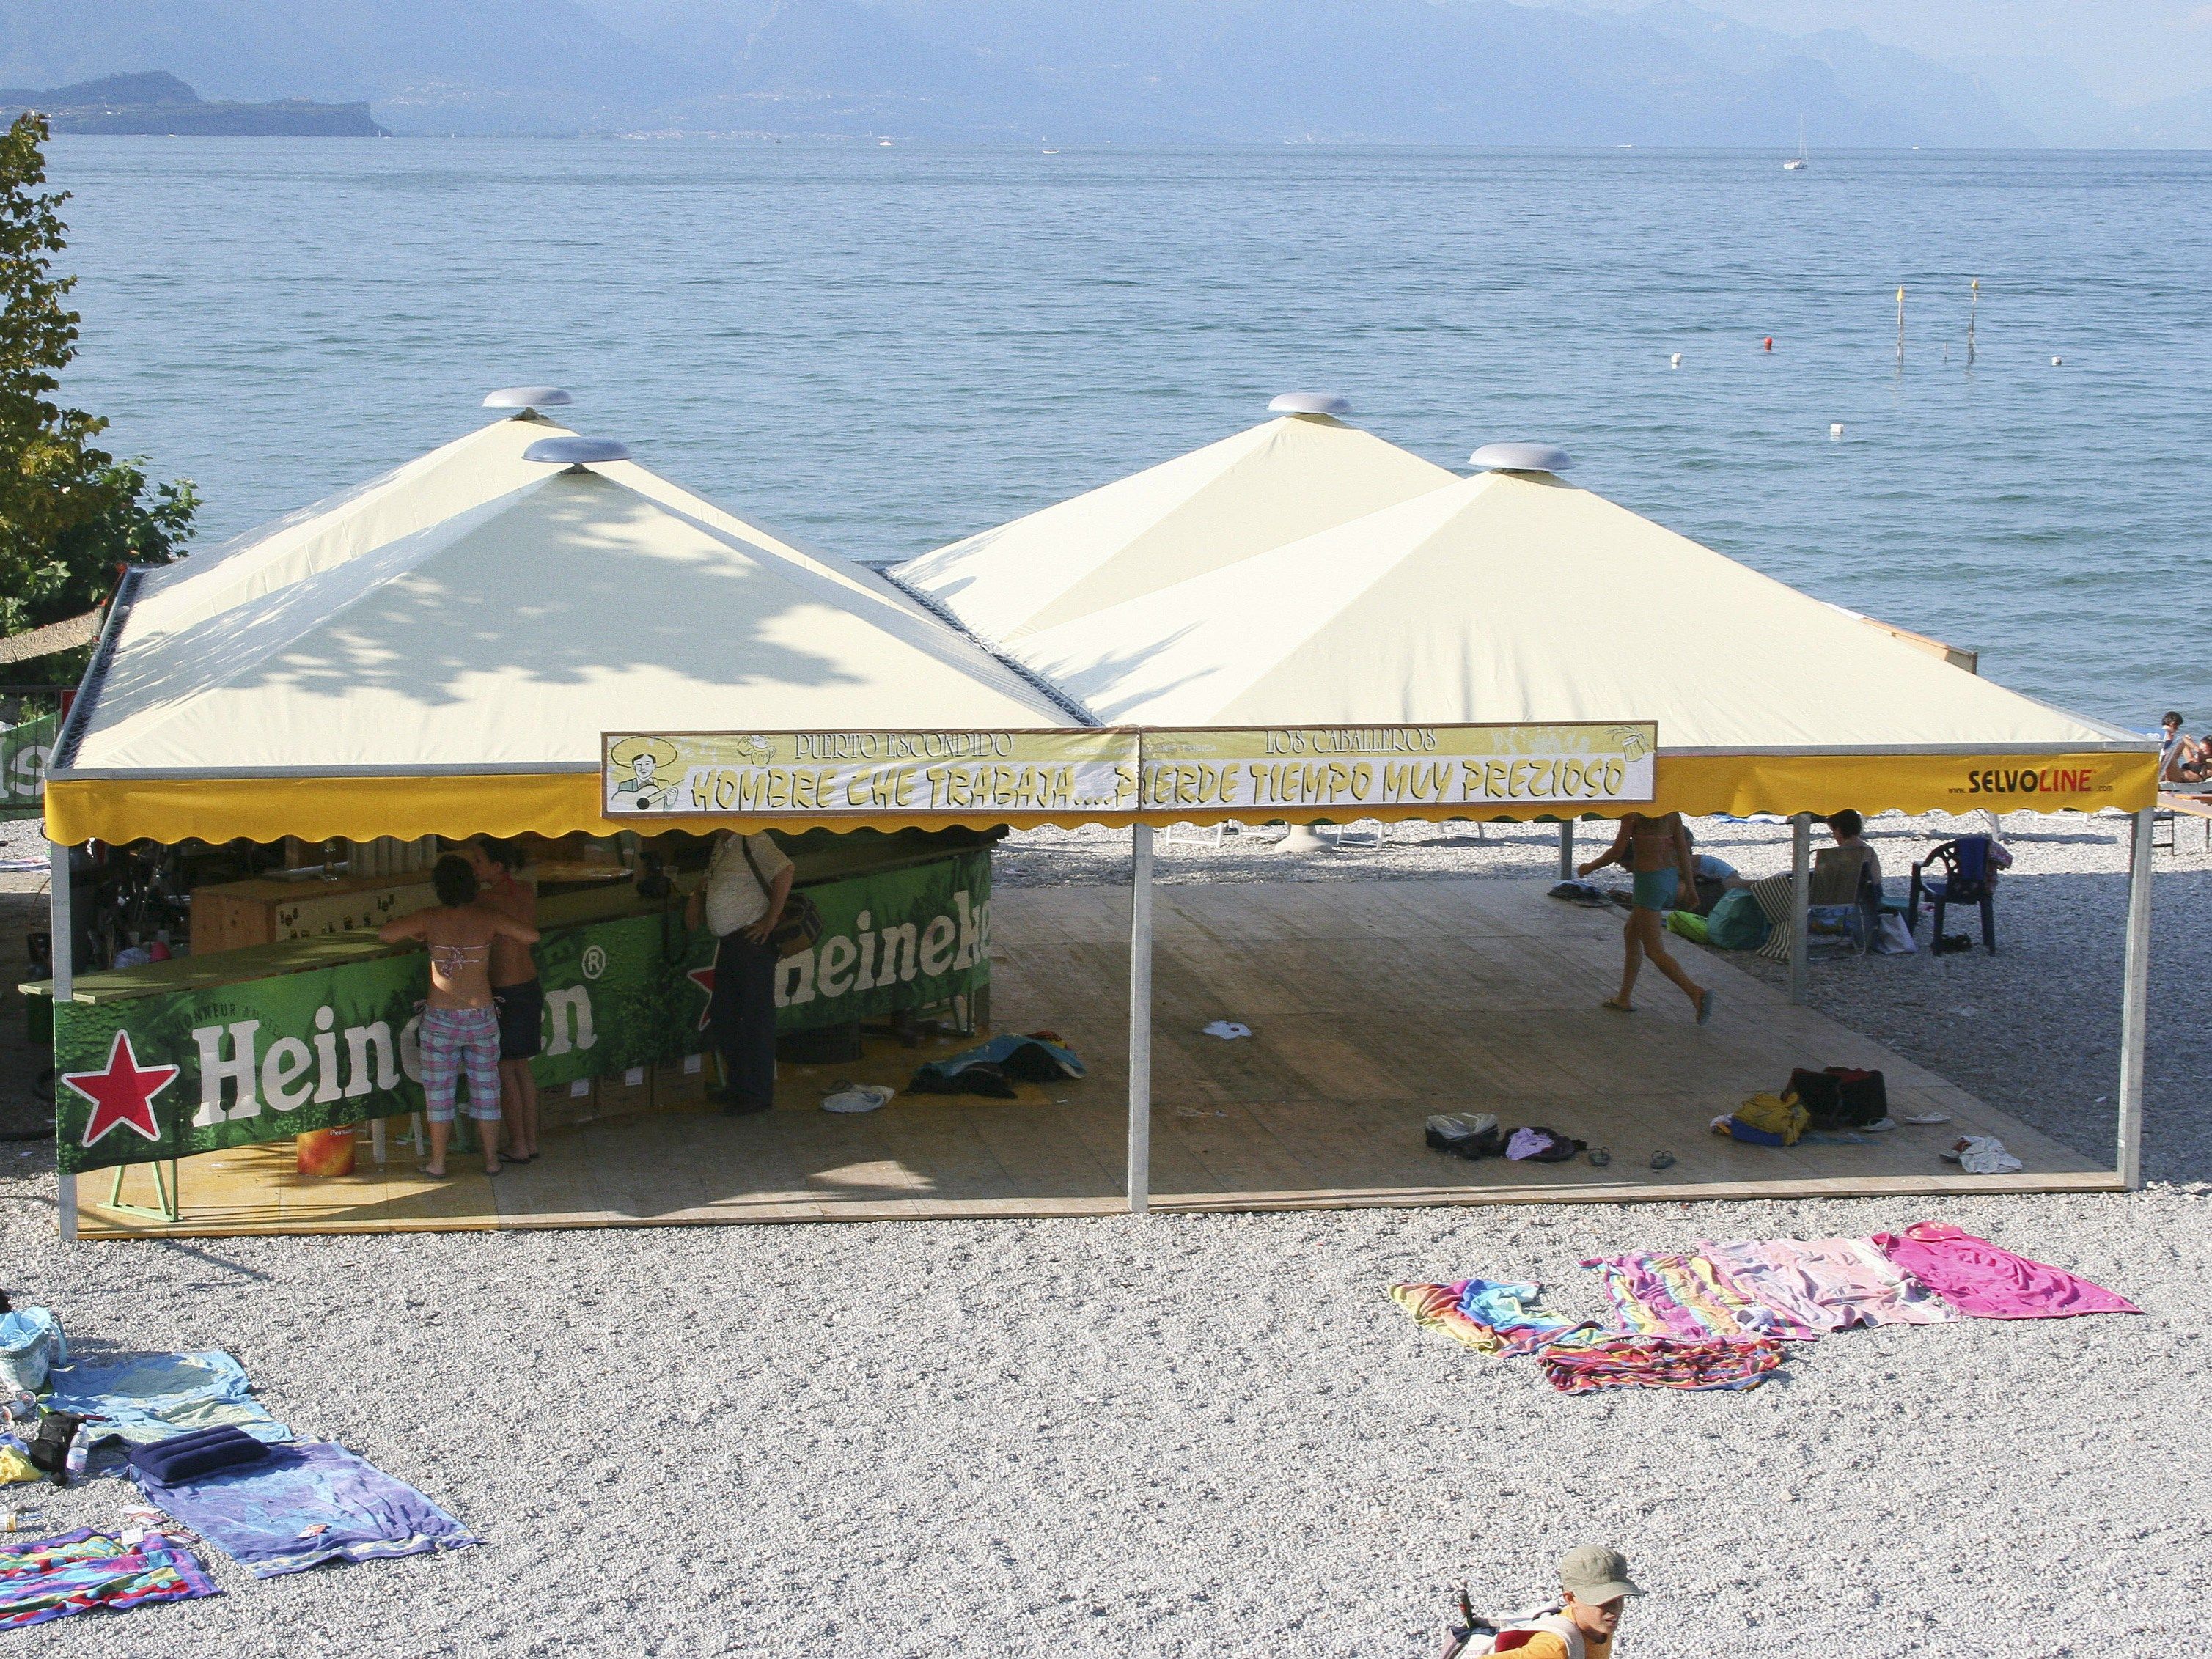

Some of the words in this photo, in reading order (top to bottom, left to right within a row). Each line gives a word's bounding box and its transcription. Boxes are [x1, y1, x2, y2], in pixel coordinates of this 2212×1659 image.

[794, 732, 878, 759] PUERTO
[885, 732, 1013, 758] ESCONDIDO
[1265, 729, 1307, 754] LOS
[1312, 728, 1438, 754] CABALLEROS
[691, 768, 839, 812] HOMBRE
[846, 766, 917, 811] CHE
[1114, 759, 1241, 808] PIERDE
[1249, 760, 1375, 806] TIEMPO
[1382, 759, 1455, 803] MUY
[1462, 756, 1627, 801] PREZIOSO
[1968, 769, 2092, 794] SELVOLINE
[192, 984, 598, 1127] Heinn
